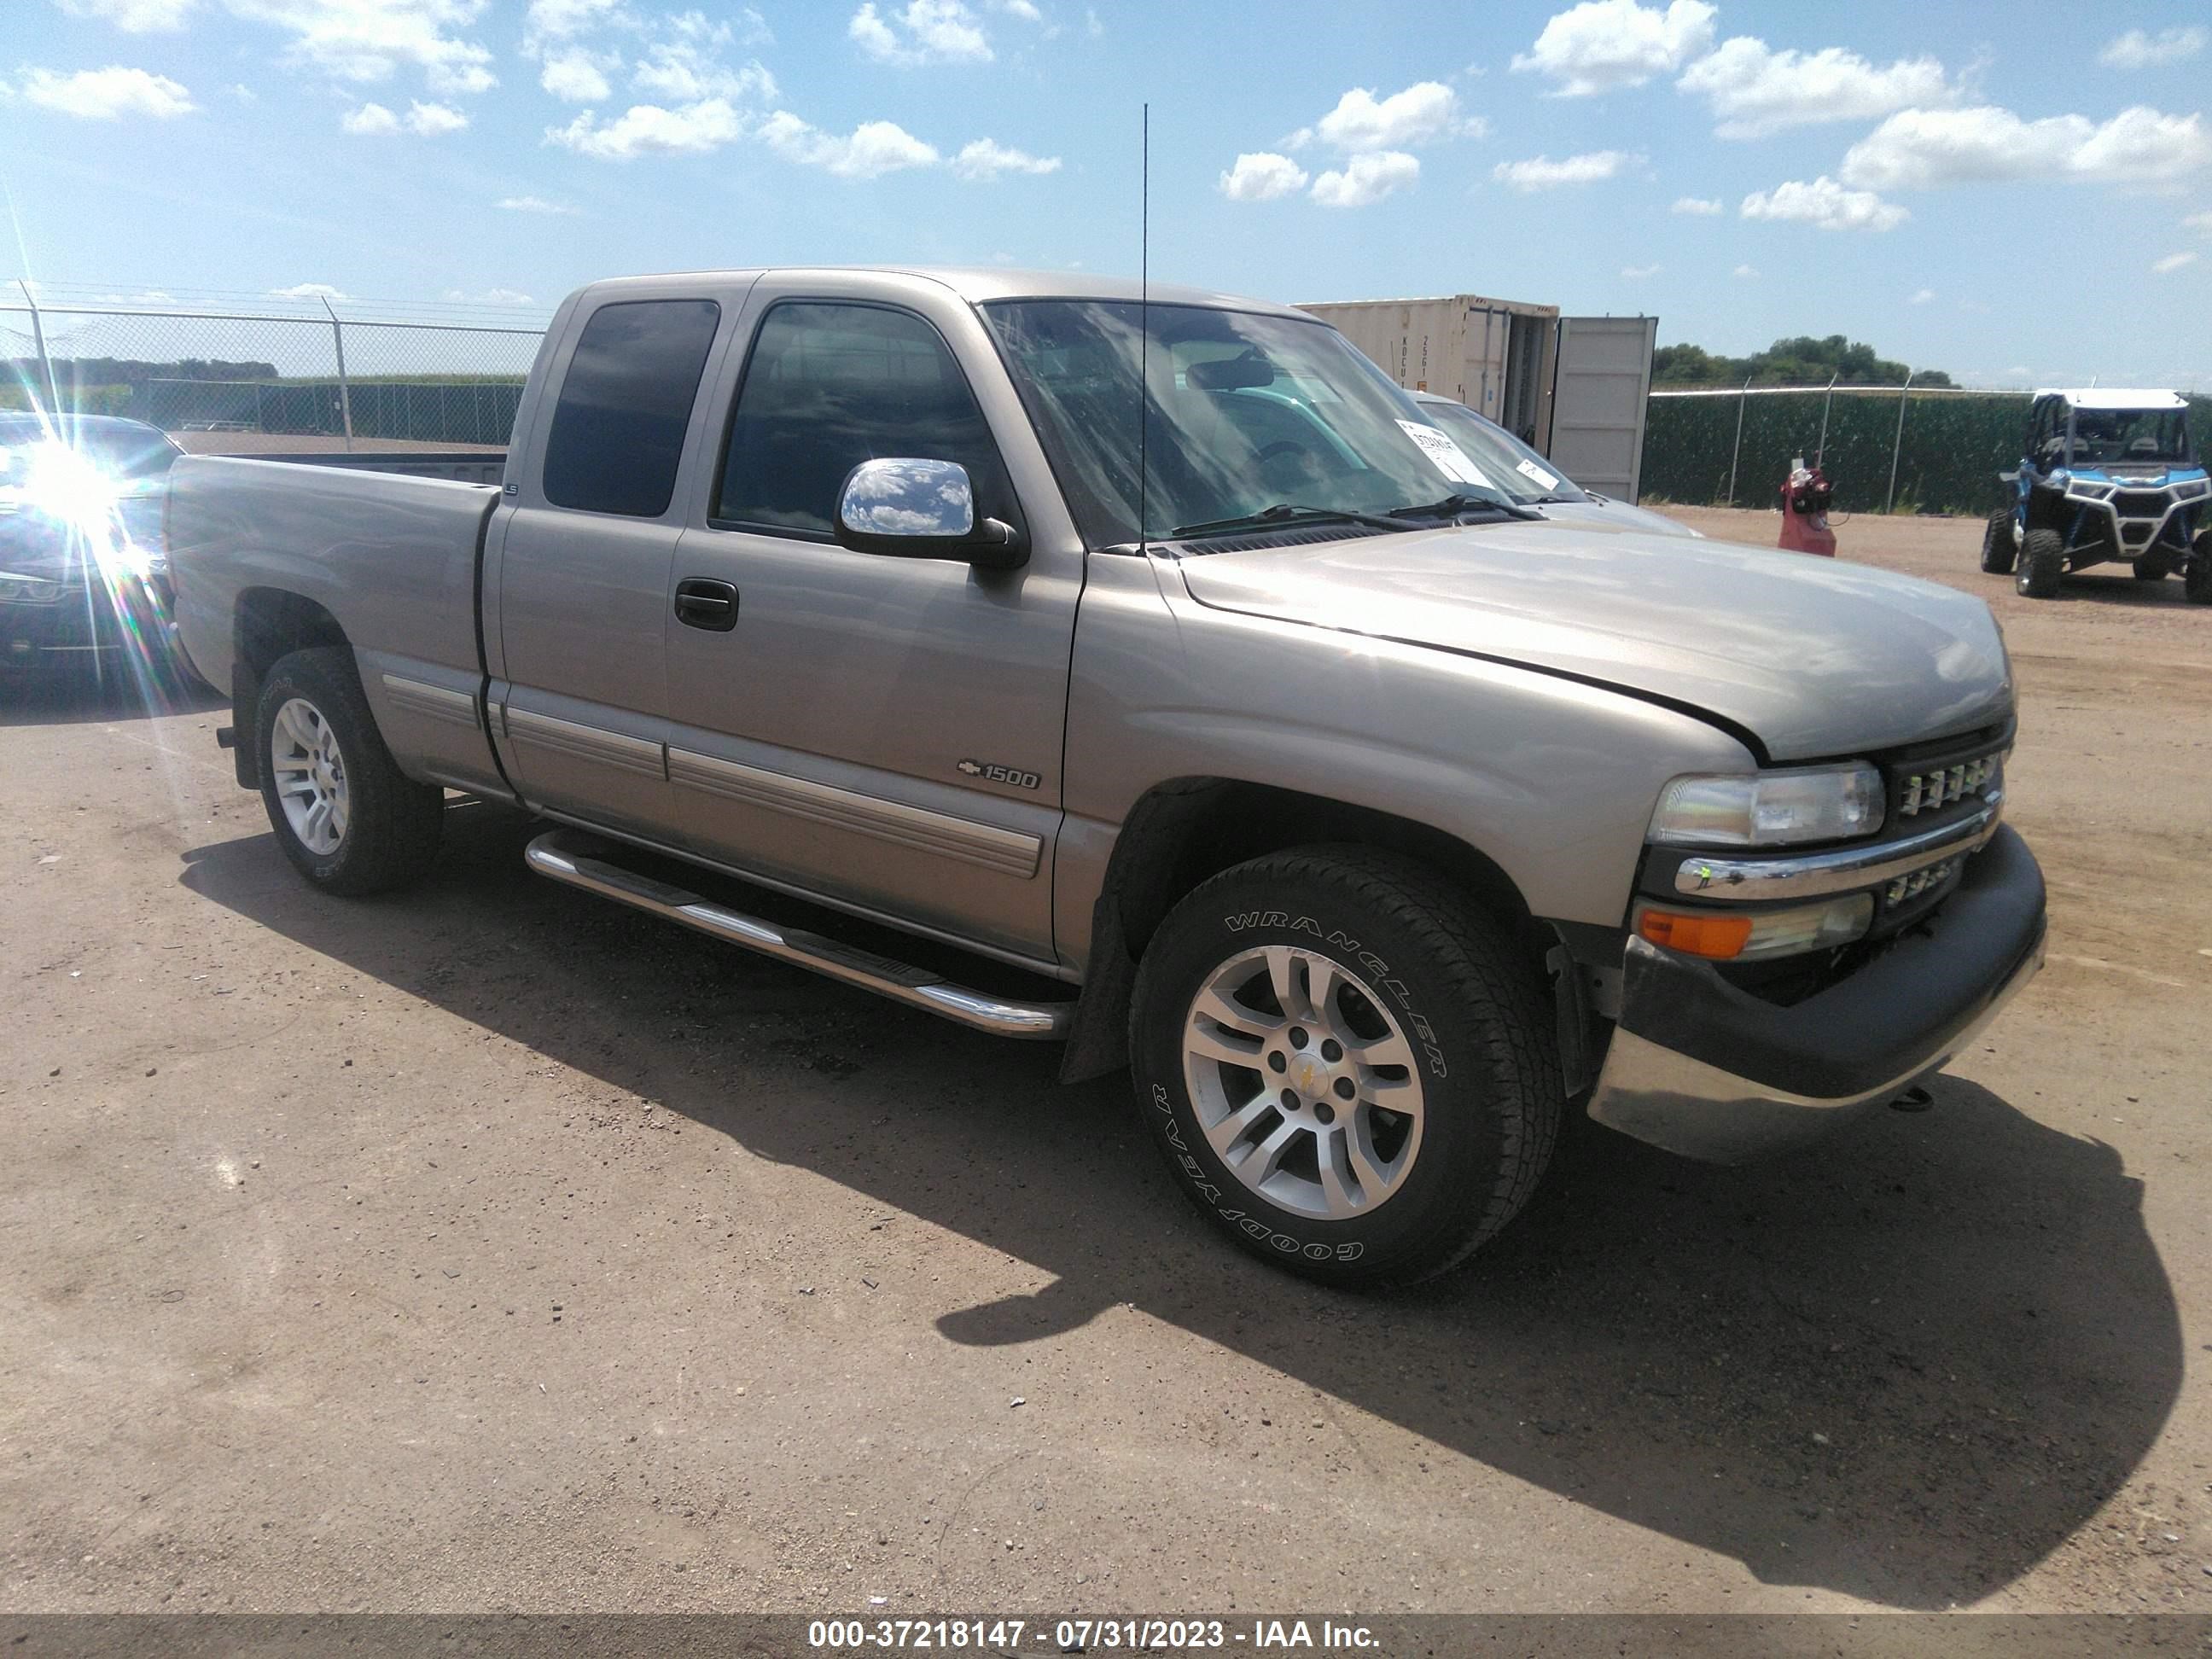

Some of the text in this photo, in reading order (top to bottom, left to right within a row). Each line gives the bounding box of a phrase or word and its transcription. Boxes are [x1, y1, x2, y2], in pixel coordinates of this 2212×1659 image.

[986, 765, 1038, 788] 1500
[1224, 911, 1447, 1079] WRANGLER
[1152, 1084, 1365, 1261] GOODYEAR
